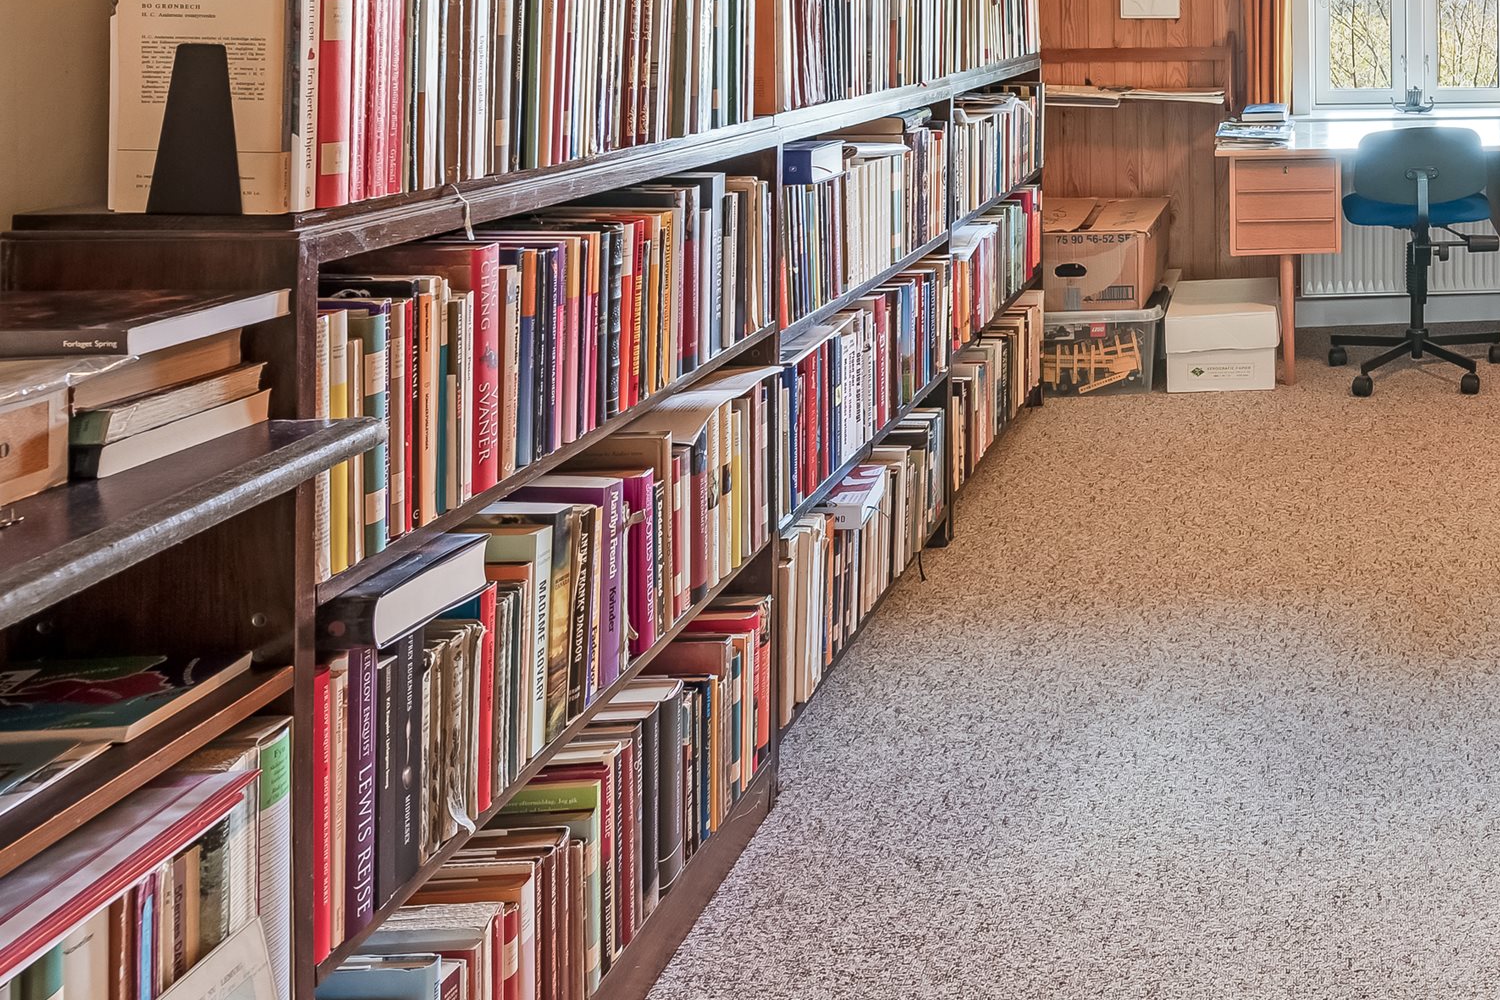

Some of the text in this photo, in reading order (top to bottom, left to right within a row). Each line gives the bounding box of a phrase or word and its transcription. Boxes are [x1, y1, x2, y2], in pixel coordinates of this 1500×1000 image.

[154, 2, 201, 10] GRØNBECH
[307, 67, 315, 86] Fra
[306, 87, 315, 121] hjerte
[306, 121, 314, 135] til
[304, 135, 313, 169] hjerte
[1056, 235, 1068, 245] 75
[1071, 235, 1083, 244] 90
[481, 261, 491, 331] CHANG
[62, 340, 118, 349] Forlaget Spring
[478, 382, 491, 465] SVANER
[607, 490, 620, 633] Marilyn French Kvinder
[574, 532, 589, 663] ANNE DAGBOG
[536, 579, 548, 702] MADAME BOVARY
[363, 672, 371, 702] OLOV
[362, 707, 370, 758] ENQUIST
[604, 806, 612, 839] Helle
[353, 762, 372, 918] LEWIS REJSE
[604, 902, 612, 957] hundene
